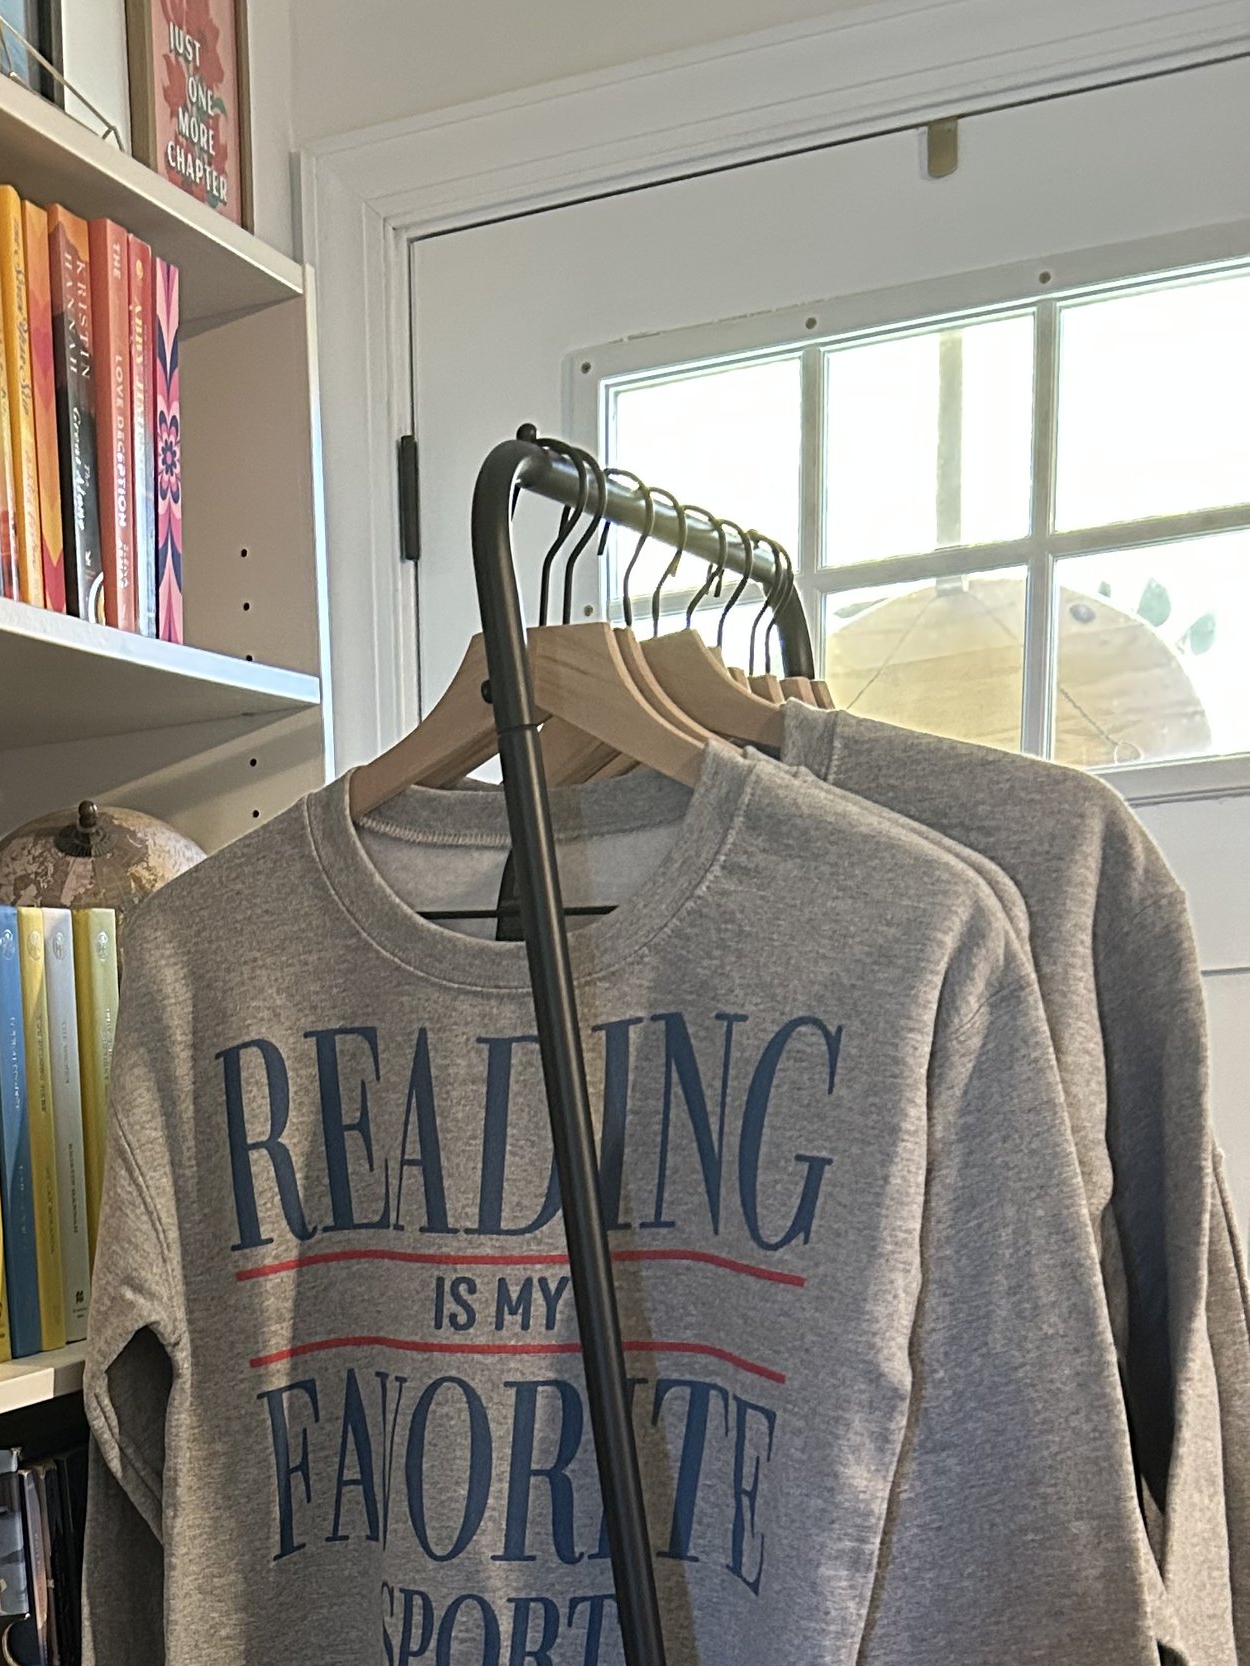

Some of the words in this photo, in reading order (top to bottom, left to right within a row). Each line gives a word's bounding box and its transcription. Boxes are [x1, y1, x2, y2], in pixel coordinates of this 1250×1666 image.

[169, 21, 201, 67] JUST
[188, 76, 215, 117] ONE
[178, 106, 216, 156] MORE
[167, 140, 228, 202] CHAPTER
[75, 260, 92, 379] KRISTIN
[114, 355, 126, 410] LOVE
[215, 1011, 843, 1253] READING
[433, 1276, 478, 1331] IS
[494, 1276, 570, 1331] MY
[257, 1367, 778, 1597] FAVORTE
